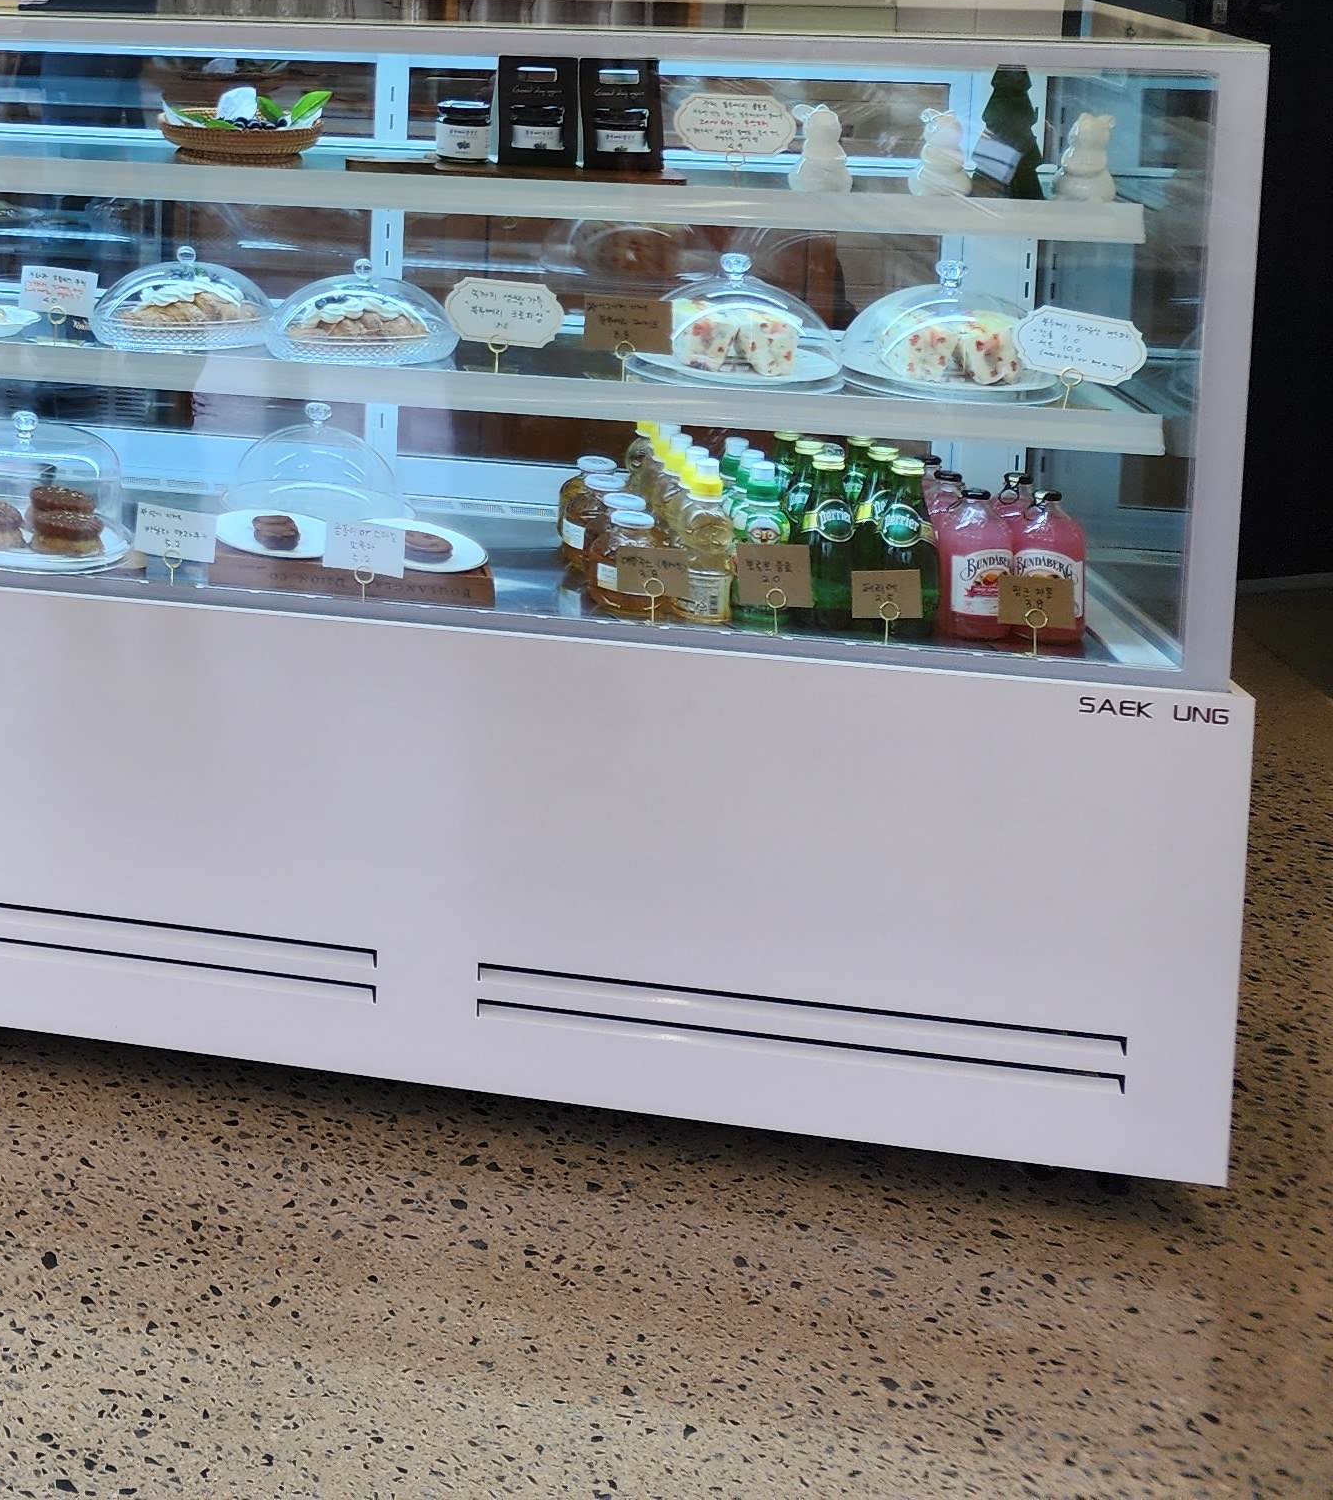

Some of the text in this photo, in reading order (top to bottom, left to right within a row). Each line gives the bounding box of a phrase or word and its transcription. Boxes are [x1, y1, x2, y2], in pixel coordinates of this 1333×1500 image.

[819, 508, 852, 531] perrier
[882, 513, 920, 534] perrier
[1016, 555, 1079, 582] BUNDABERG
[862, 582, 898, 594] 페리에
[1079, 696, 1230, 725] SAEK UNG
